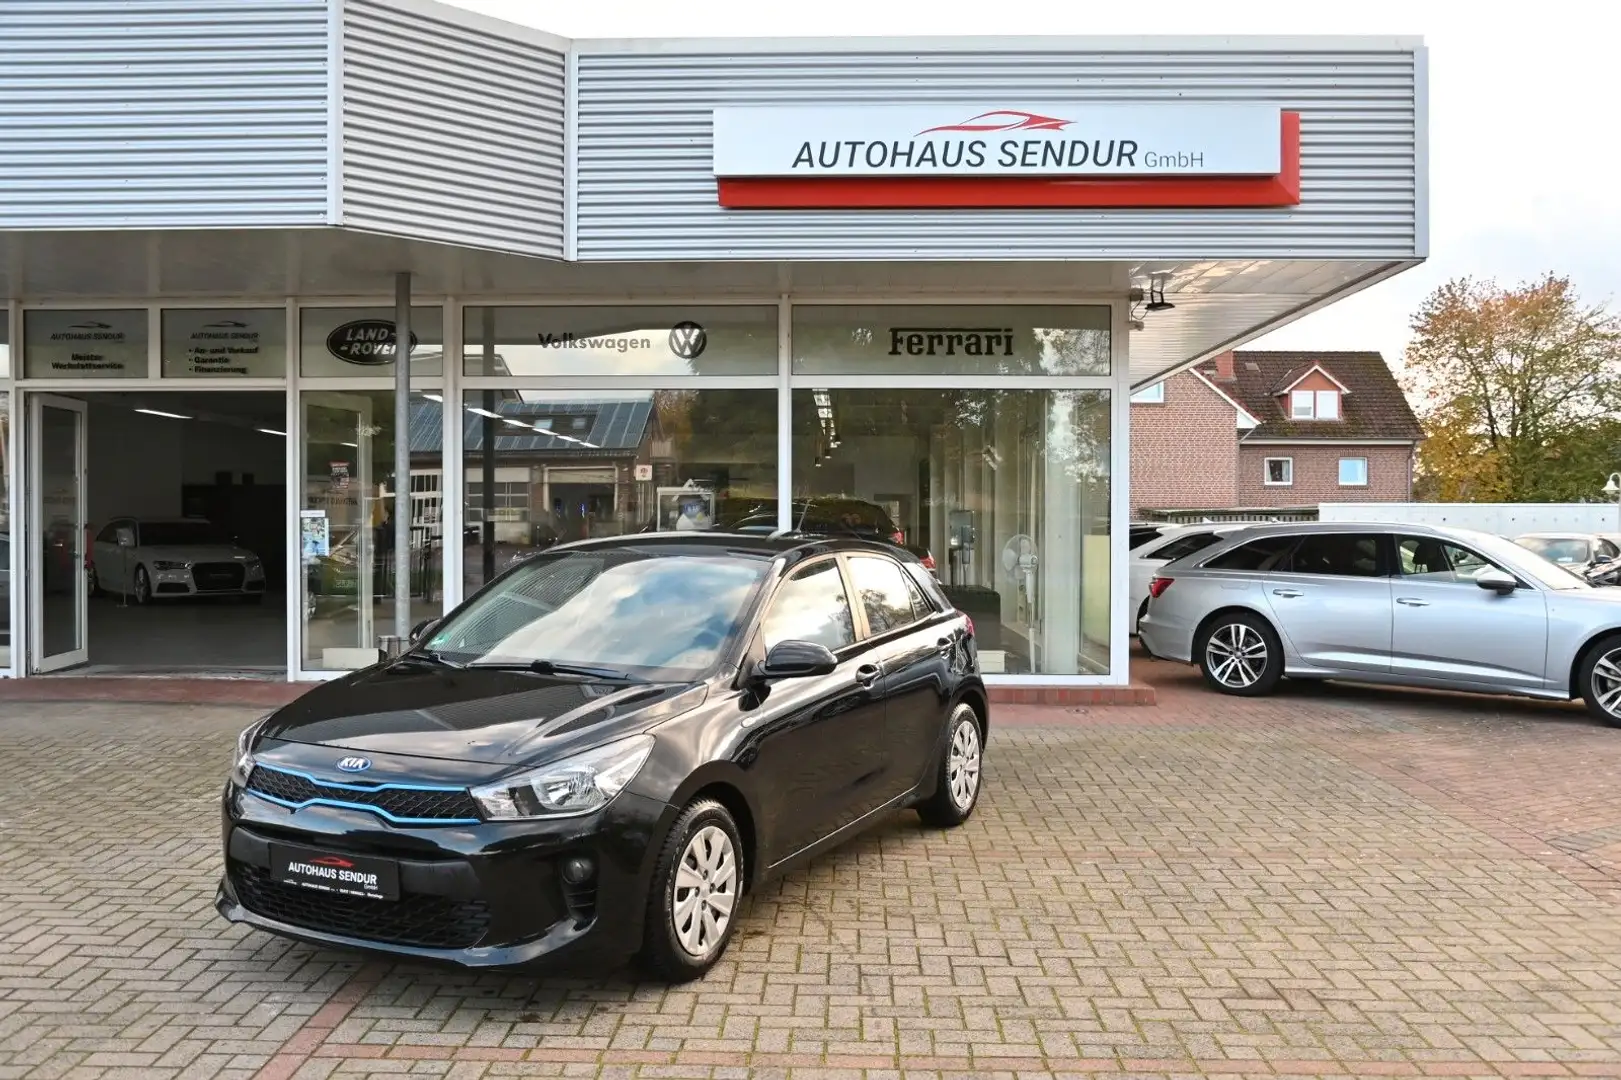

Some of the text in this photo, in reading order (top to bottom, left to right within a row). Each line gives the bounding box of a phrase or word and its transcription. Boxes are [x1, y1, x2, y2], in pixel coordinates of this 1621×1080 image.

[792, 140, 1204, 168] AUTOHAUS SENDUR GmbH
[346, 328, 389, 341] LAND
[538, 333, 650, 353] Volkswagen
[888, 327, 1014, 356] Ferrari
[340, 757, 365, 769] KIA
[288, 861, 377, 885] AUTOHAUS SENDUR
